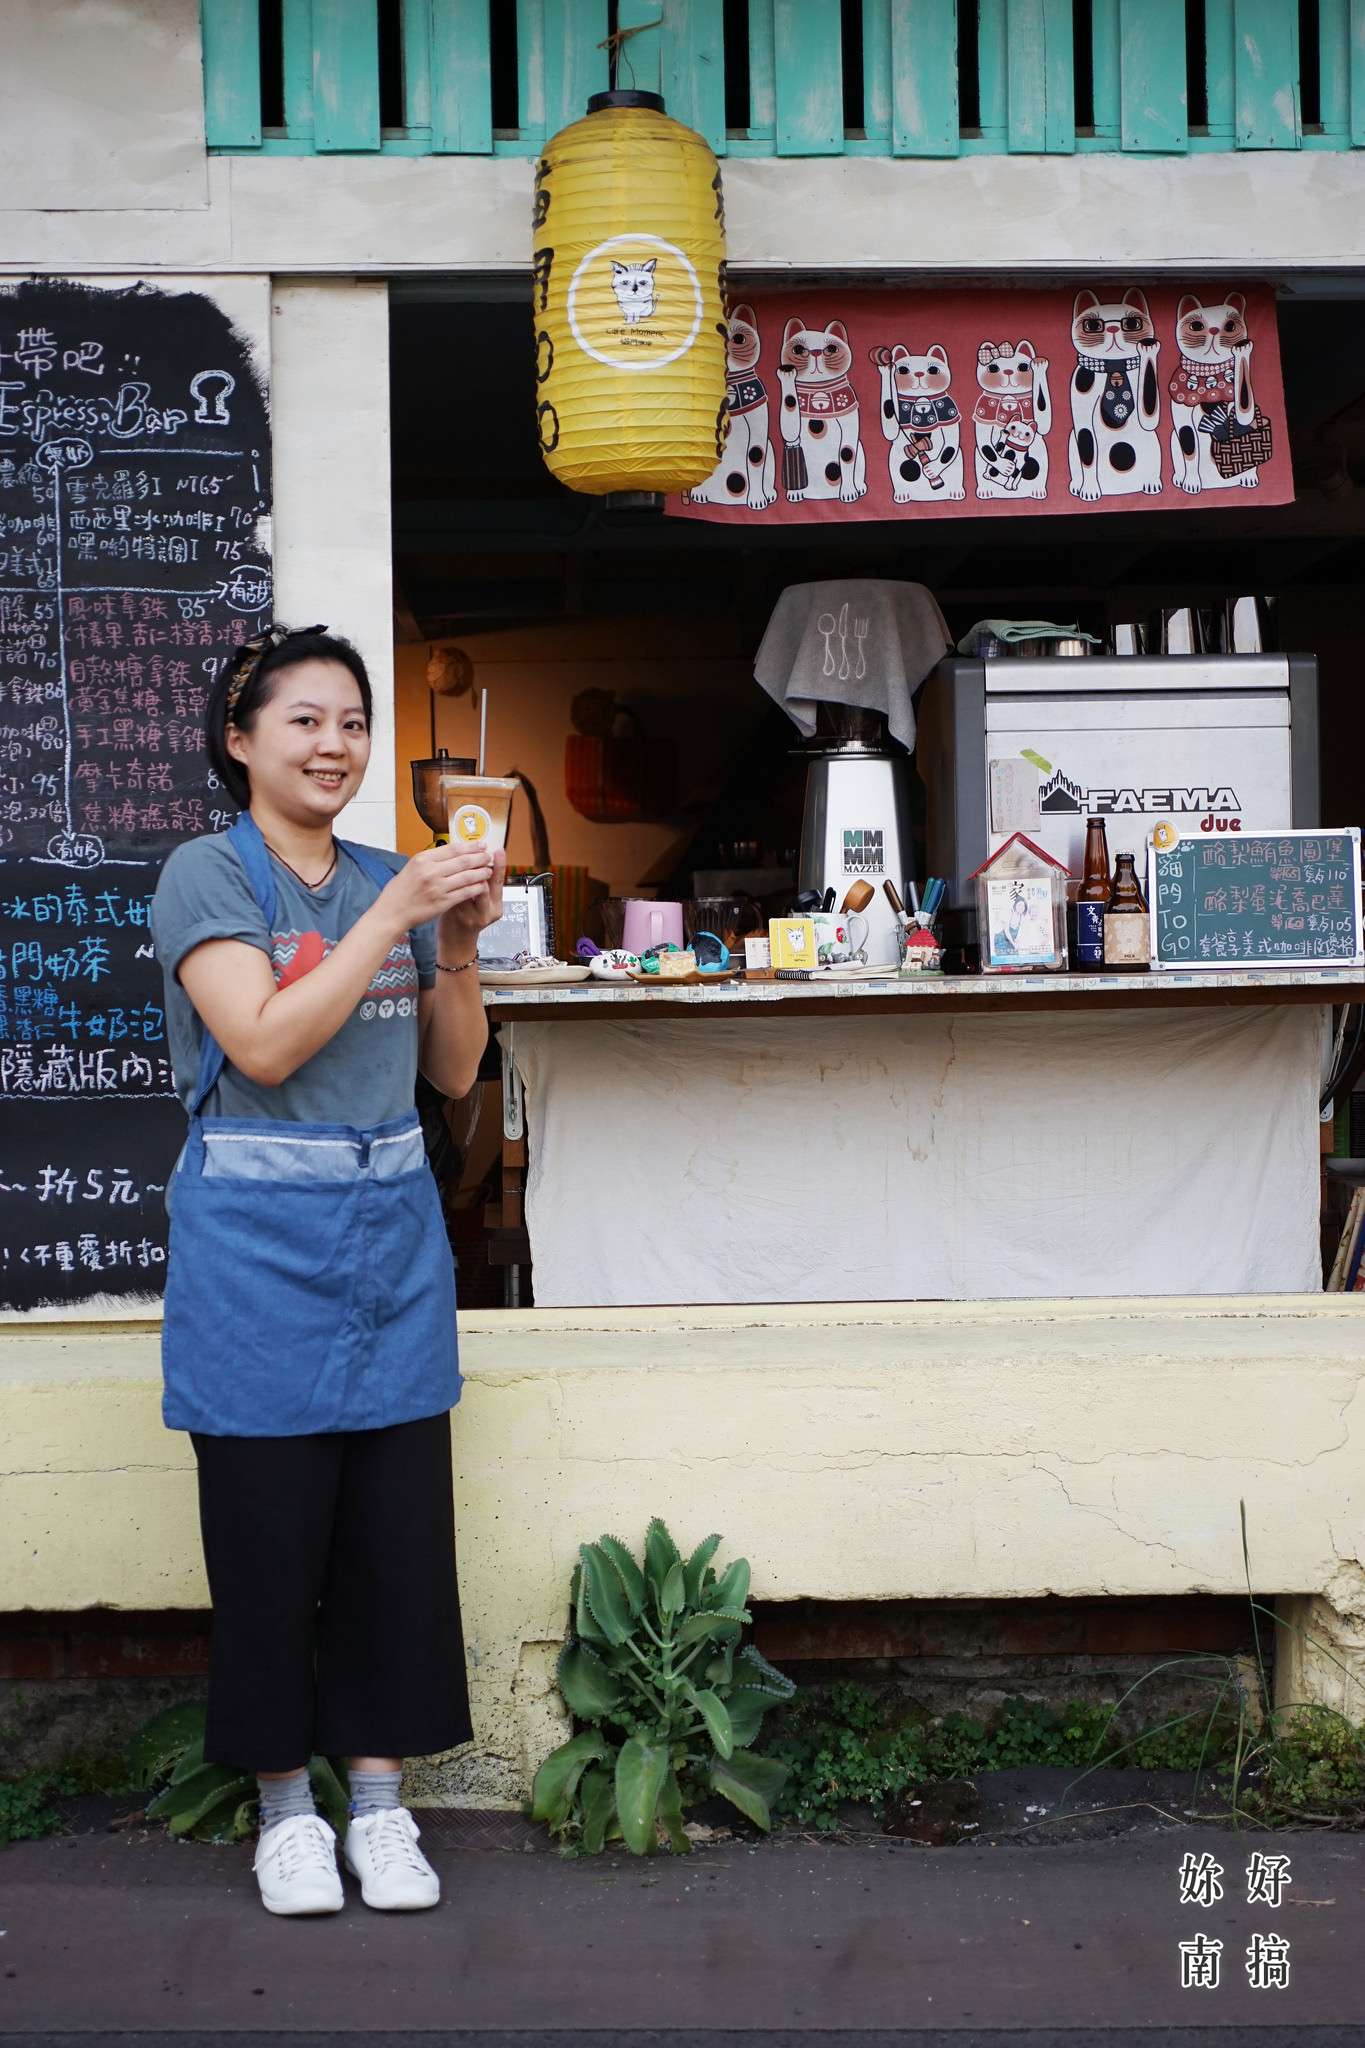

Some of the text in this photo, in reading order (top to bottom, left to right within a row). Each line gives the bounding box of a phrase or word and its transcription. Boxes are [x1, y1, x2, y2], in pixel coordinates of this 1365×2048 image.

[1086, 787, 1242, 814] FAEMA
[1200, 813, 1242, 832] due
[844, 865, 885, 873] MAZZER
